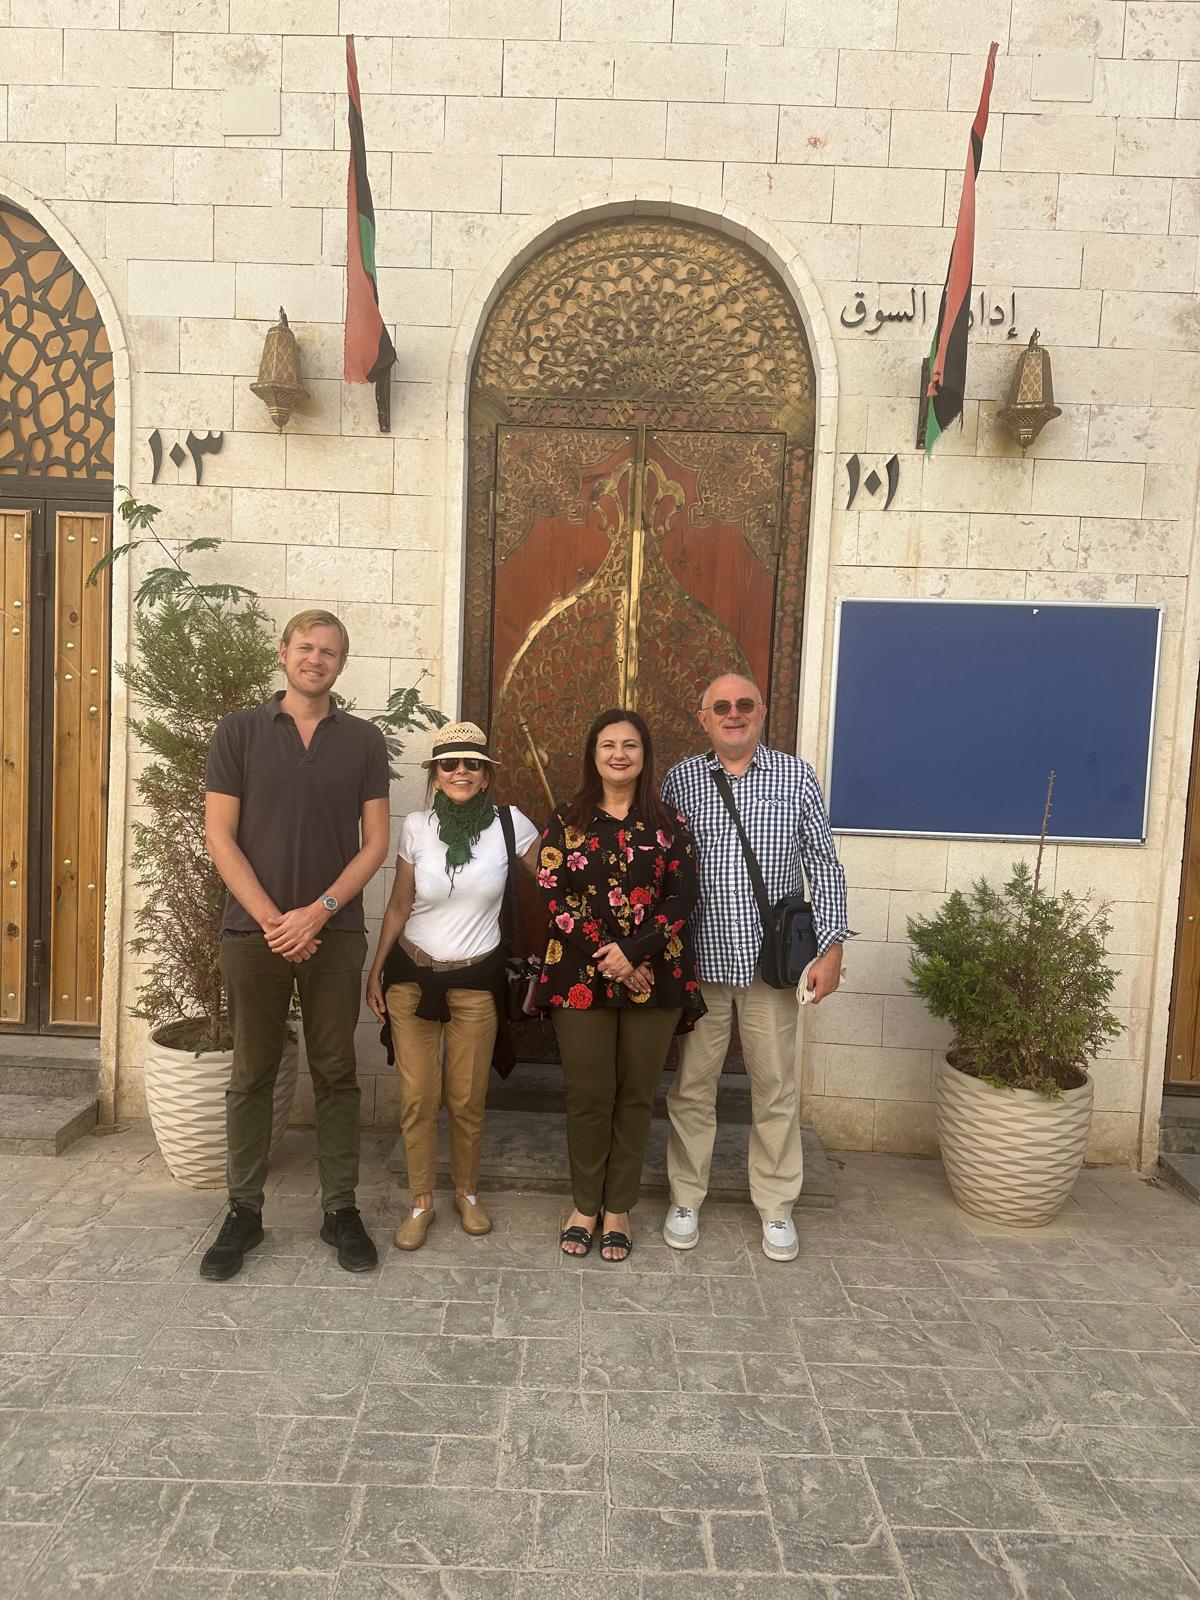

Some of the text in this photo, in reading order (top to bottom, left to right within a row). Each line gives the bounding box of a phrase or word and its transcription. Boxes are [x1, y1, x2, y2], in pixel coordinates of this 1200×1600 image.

[840, 287, 1018, 340] إدار السوق
[148, 428, 224, 485] ١٠٣
[845, 452, 900, 511] ١٠١
